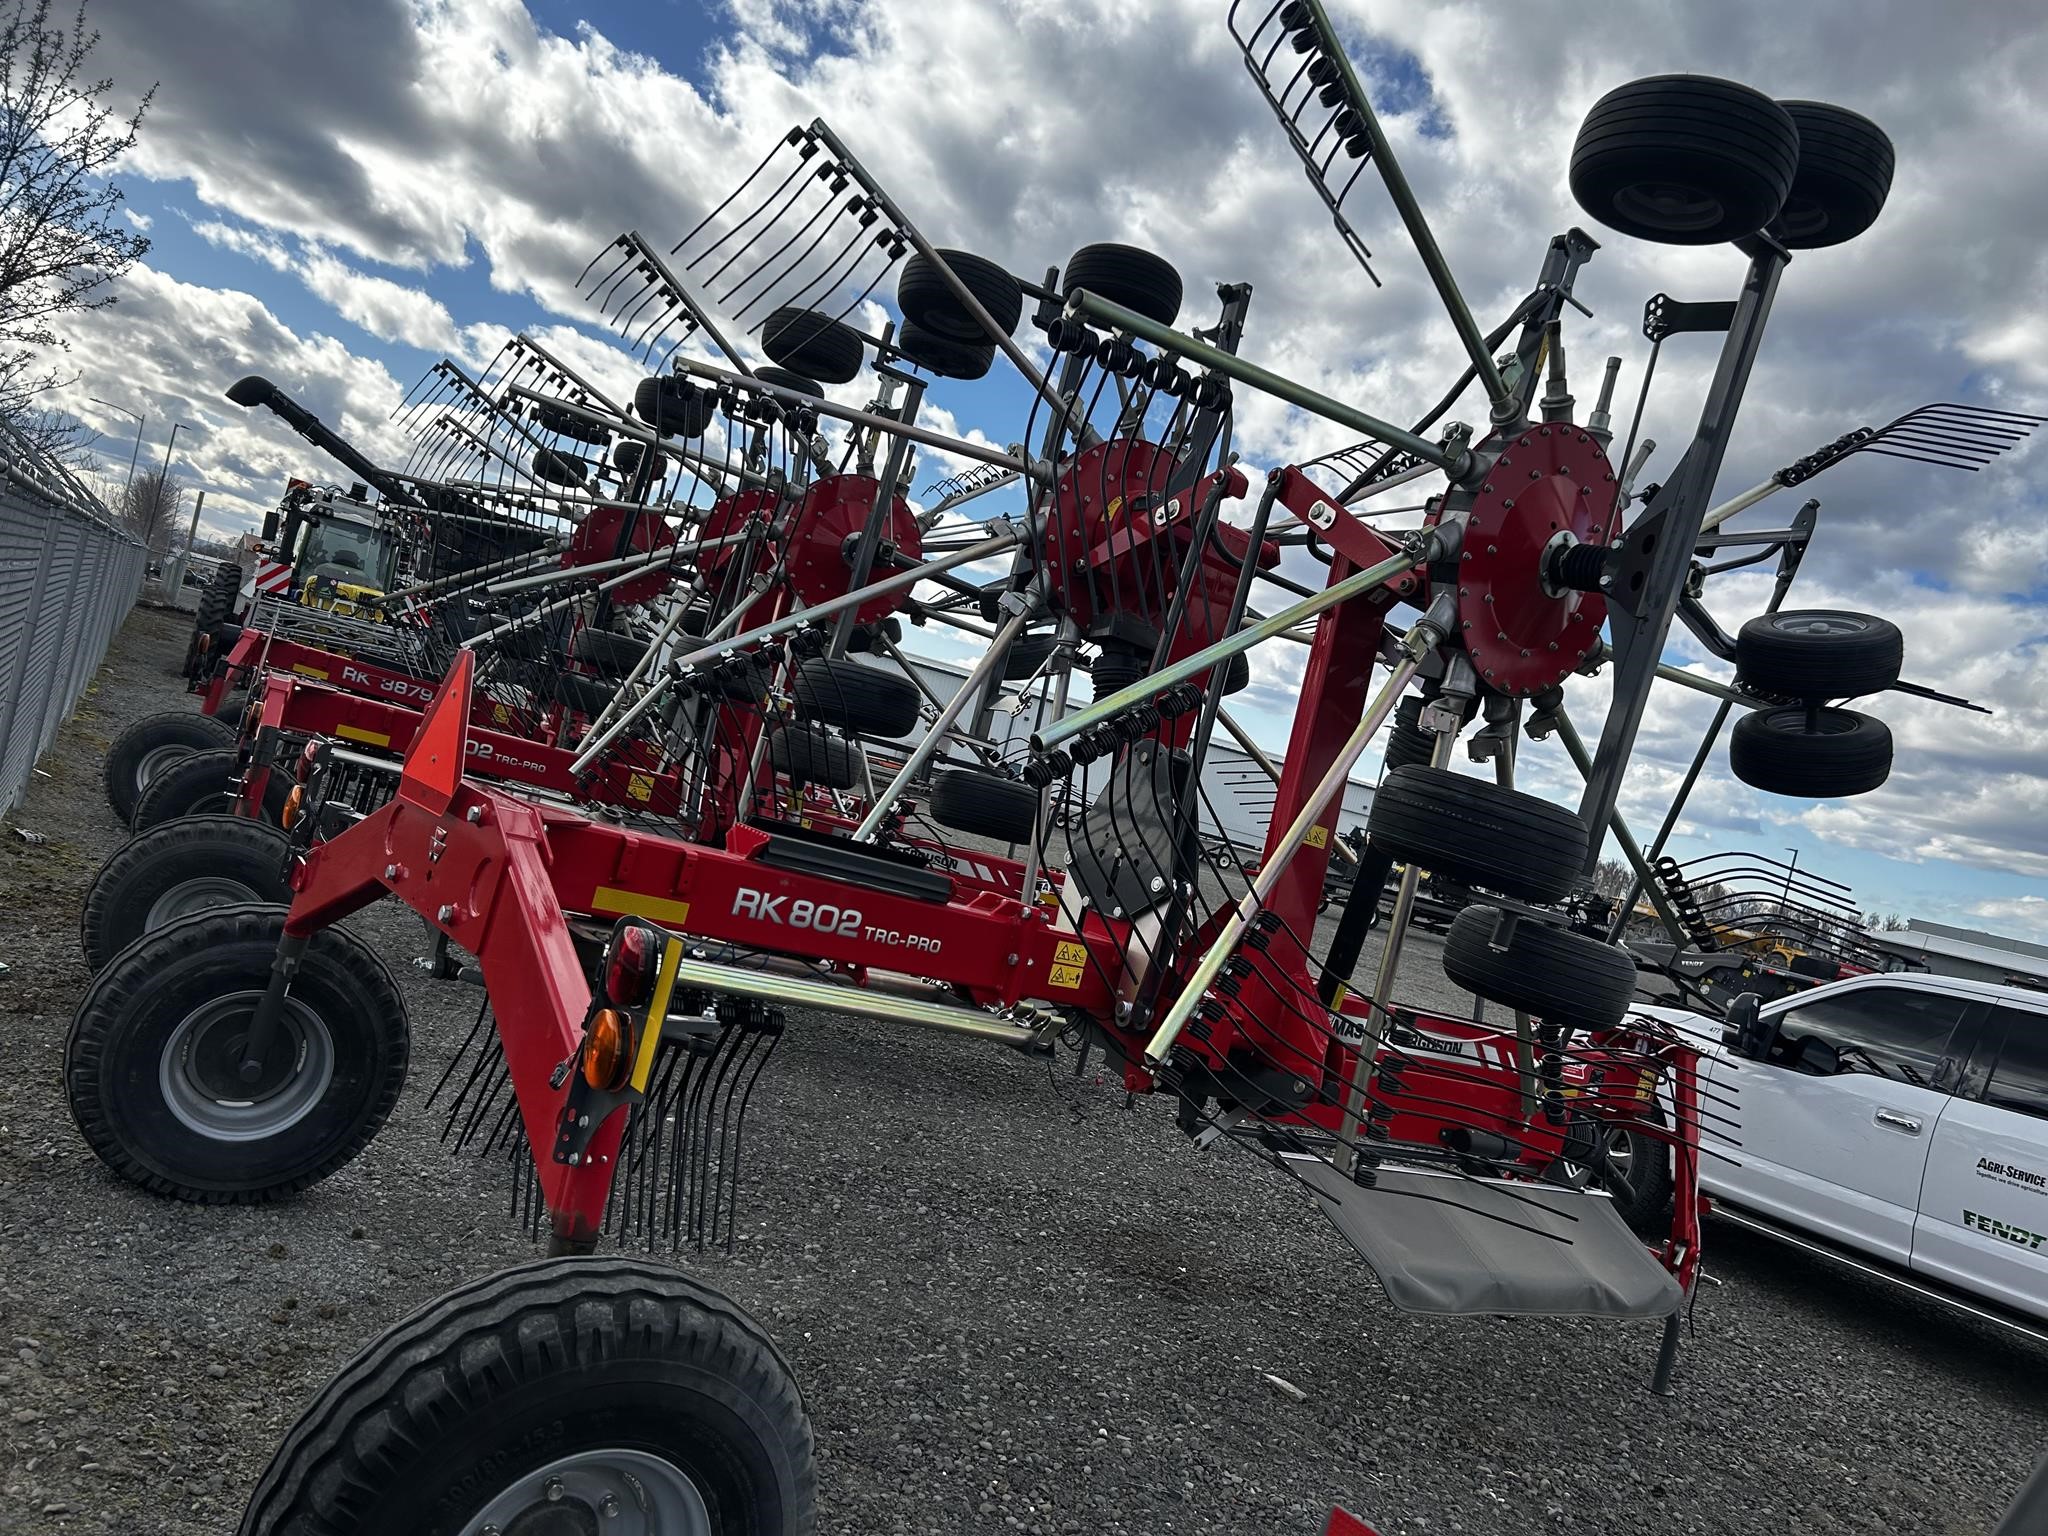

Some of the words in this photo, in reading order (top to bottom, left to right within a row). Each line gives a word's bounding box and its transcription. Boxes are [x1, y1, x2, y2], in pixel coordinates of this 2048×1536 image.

[341, 666, 370, 686] RK
[380, 678, 433, 701] 3879
[465, 739, 494, 760] 02
[495, 753, 546, 774] TRC-PRO
[731, 887, 789, 925] RK
[788, 899, 863, 939] 802
[864, 926, 942, 954] TRC-PRO
[1962, 1209, 2048, 1249] FENDT
